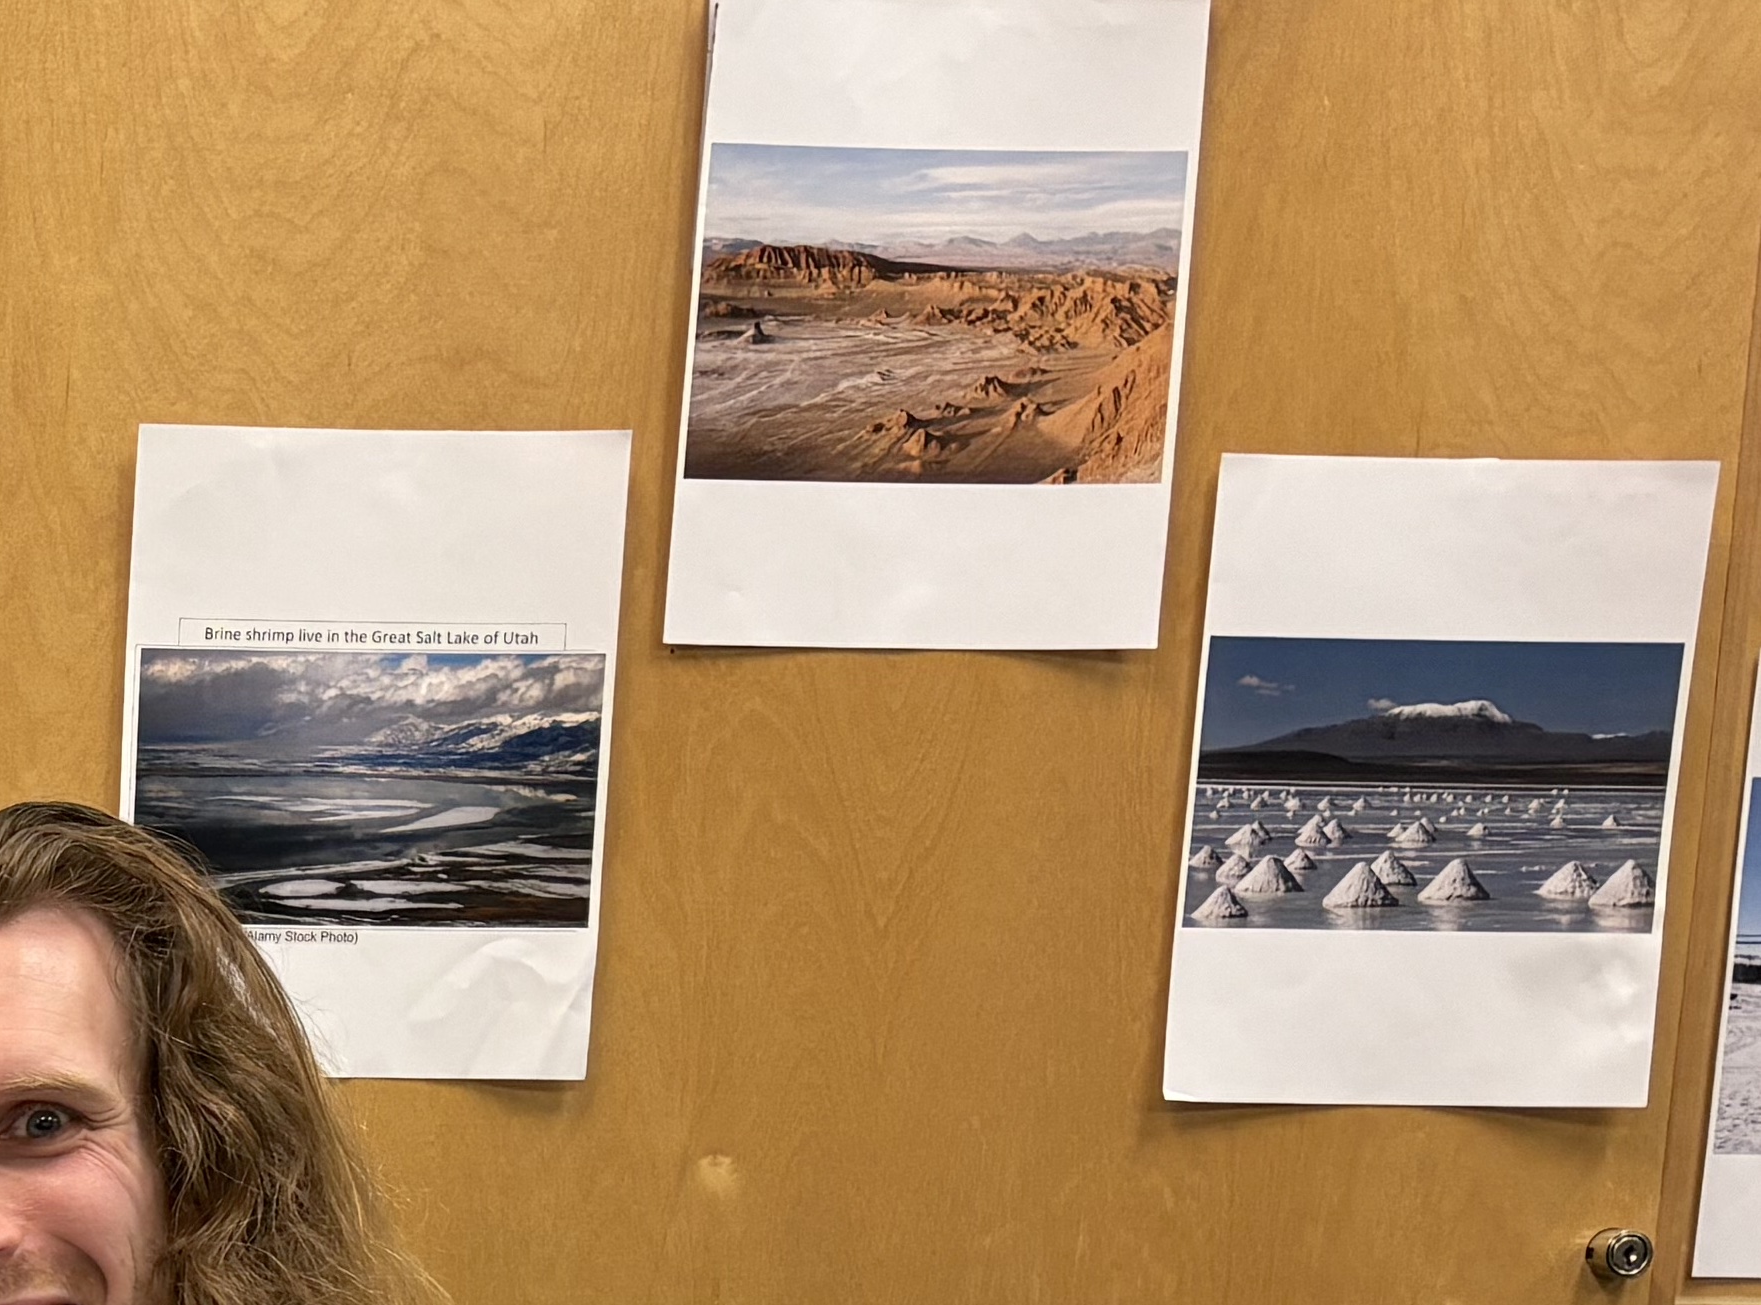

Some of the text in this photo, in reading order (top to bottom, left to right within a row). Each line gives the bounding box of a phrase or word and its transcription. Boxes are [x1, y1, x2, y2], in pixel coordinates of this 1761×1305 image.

[205, 626, 539, 645] Brine shrimp live in the Great Salt Lake of Utah
[245, 930, 359, 944] Alamy Stock Photo)
